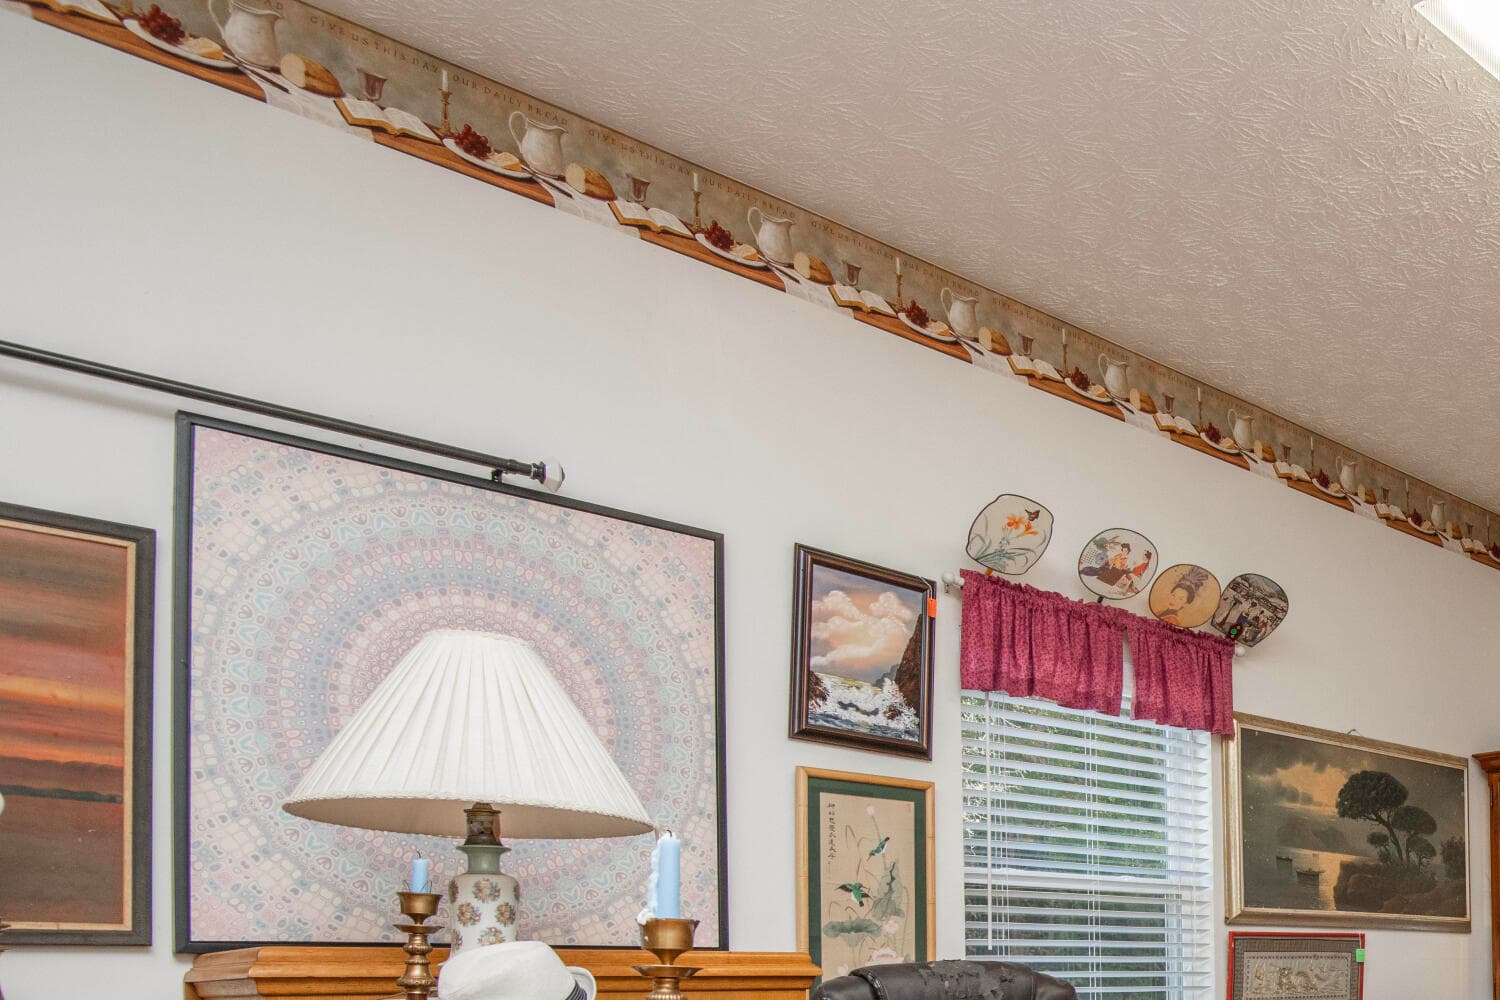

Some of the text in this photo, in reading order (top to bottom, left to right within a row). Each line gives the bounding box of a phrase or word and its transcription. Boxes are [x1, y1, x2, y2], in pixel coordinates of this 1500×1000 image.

[310, 16, 345, 35] GIVE
[351, 33, 369, 47] US
[412, 57, 438, 73] DAY
[453, 74, 477, 88] OUR
